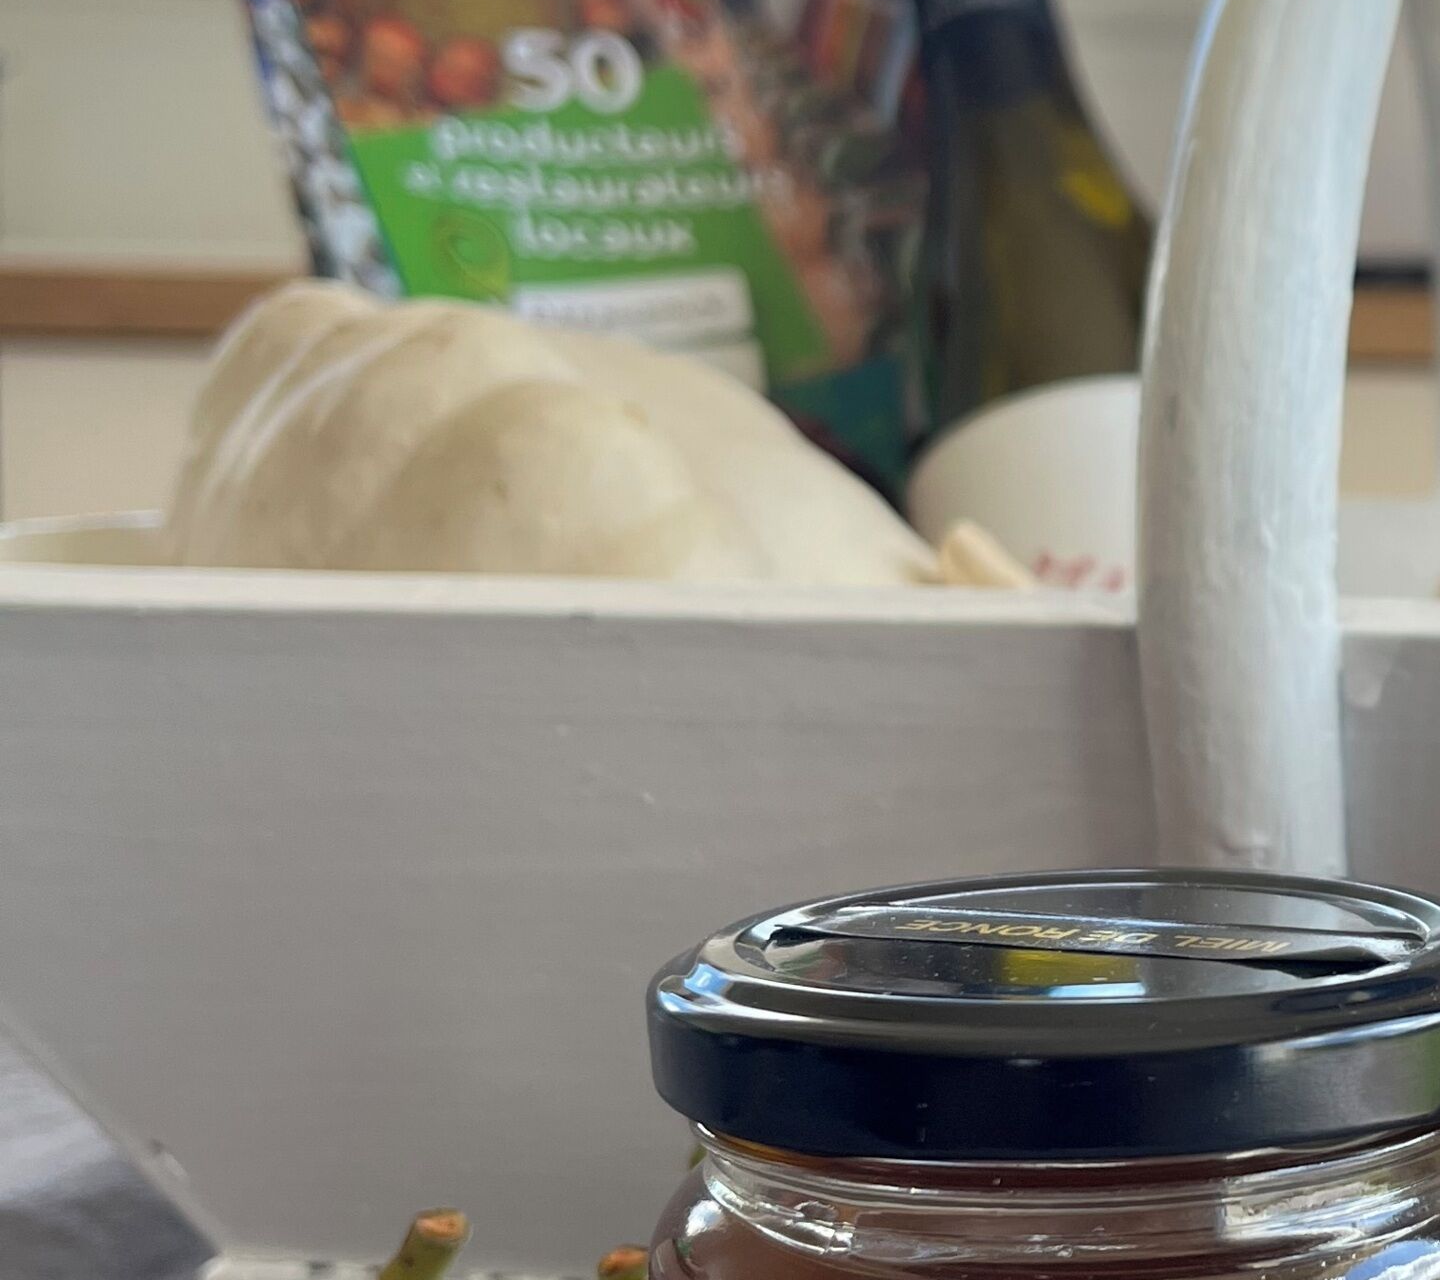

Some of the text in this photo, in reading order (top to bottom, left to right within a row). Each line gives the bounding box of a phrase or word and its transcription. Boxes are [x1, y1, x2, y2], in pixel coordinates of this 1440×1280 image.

[504, 28, 643, 113] 50
[895, 918, 1292, 953] MIEL DE RONCE
